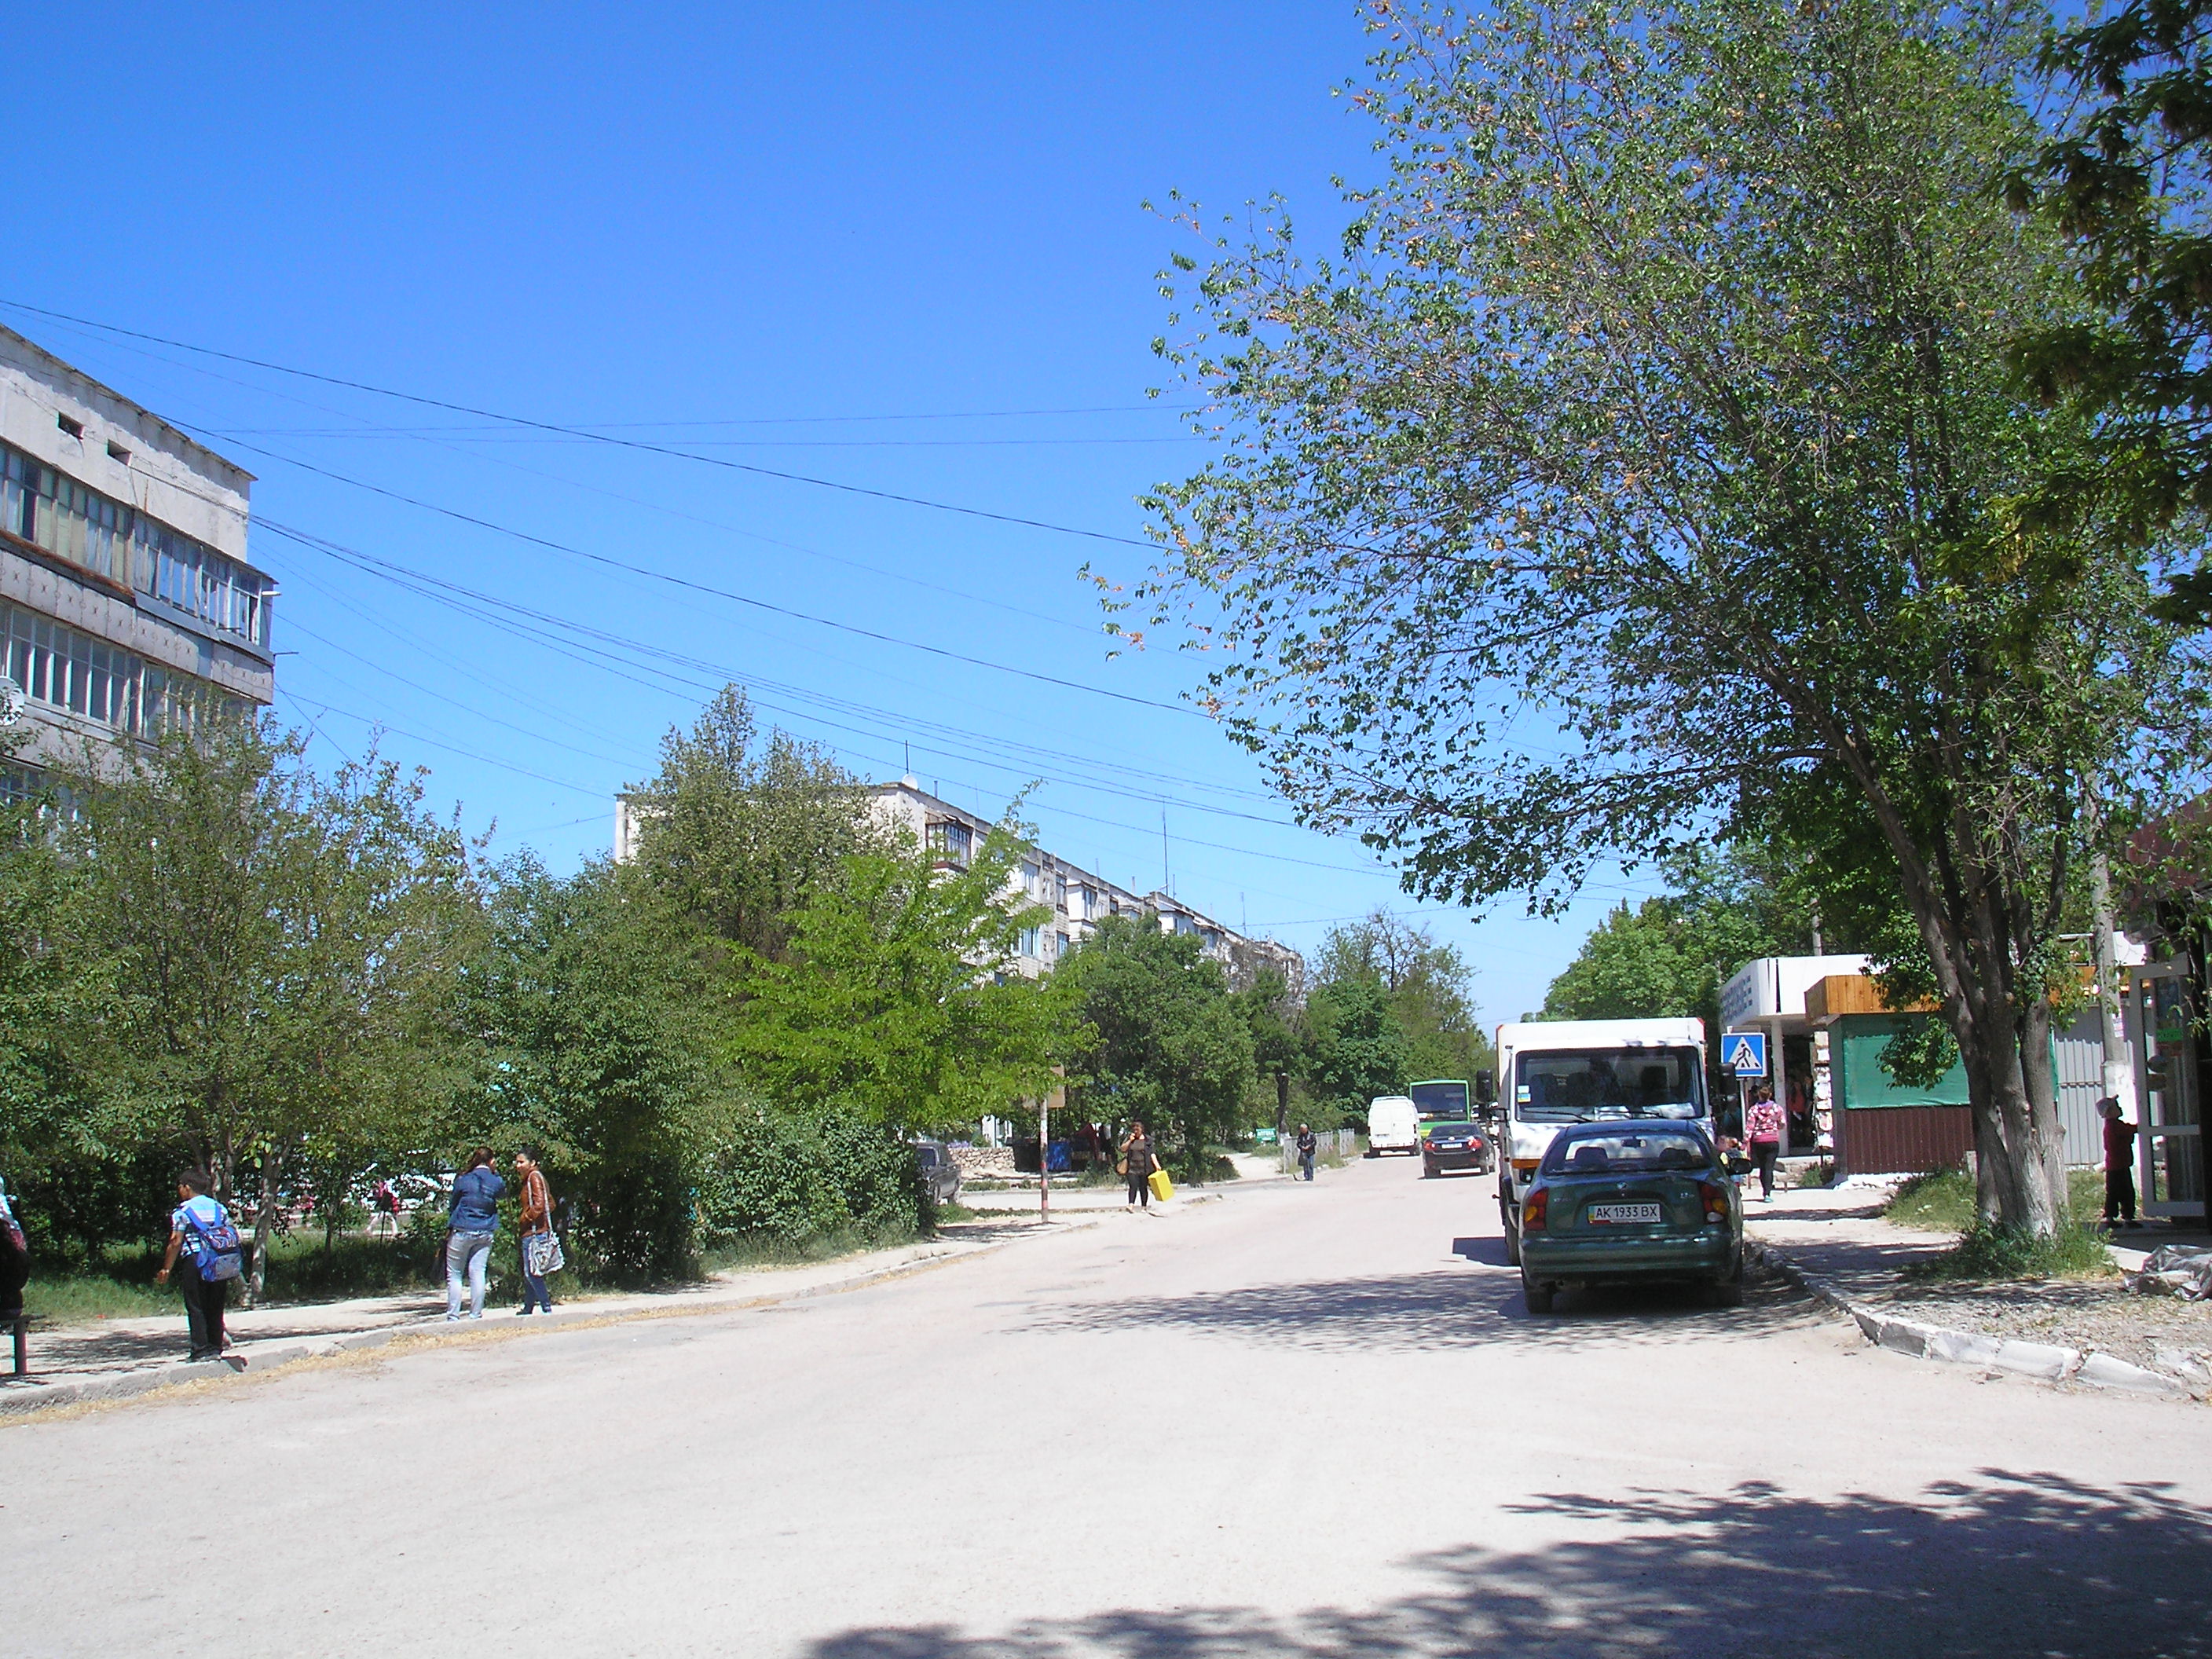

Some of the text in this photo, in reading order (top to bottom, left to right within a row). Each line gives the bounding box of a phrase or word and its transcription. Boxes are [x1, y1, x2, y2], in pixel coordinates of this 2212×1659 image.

[1595, 1206, 1657, 1218] AK 1933 BX
